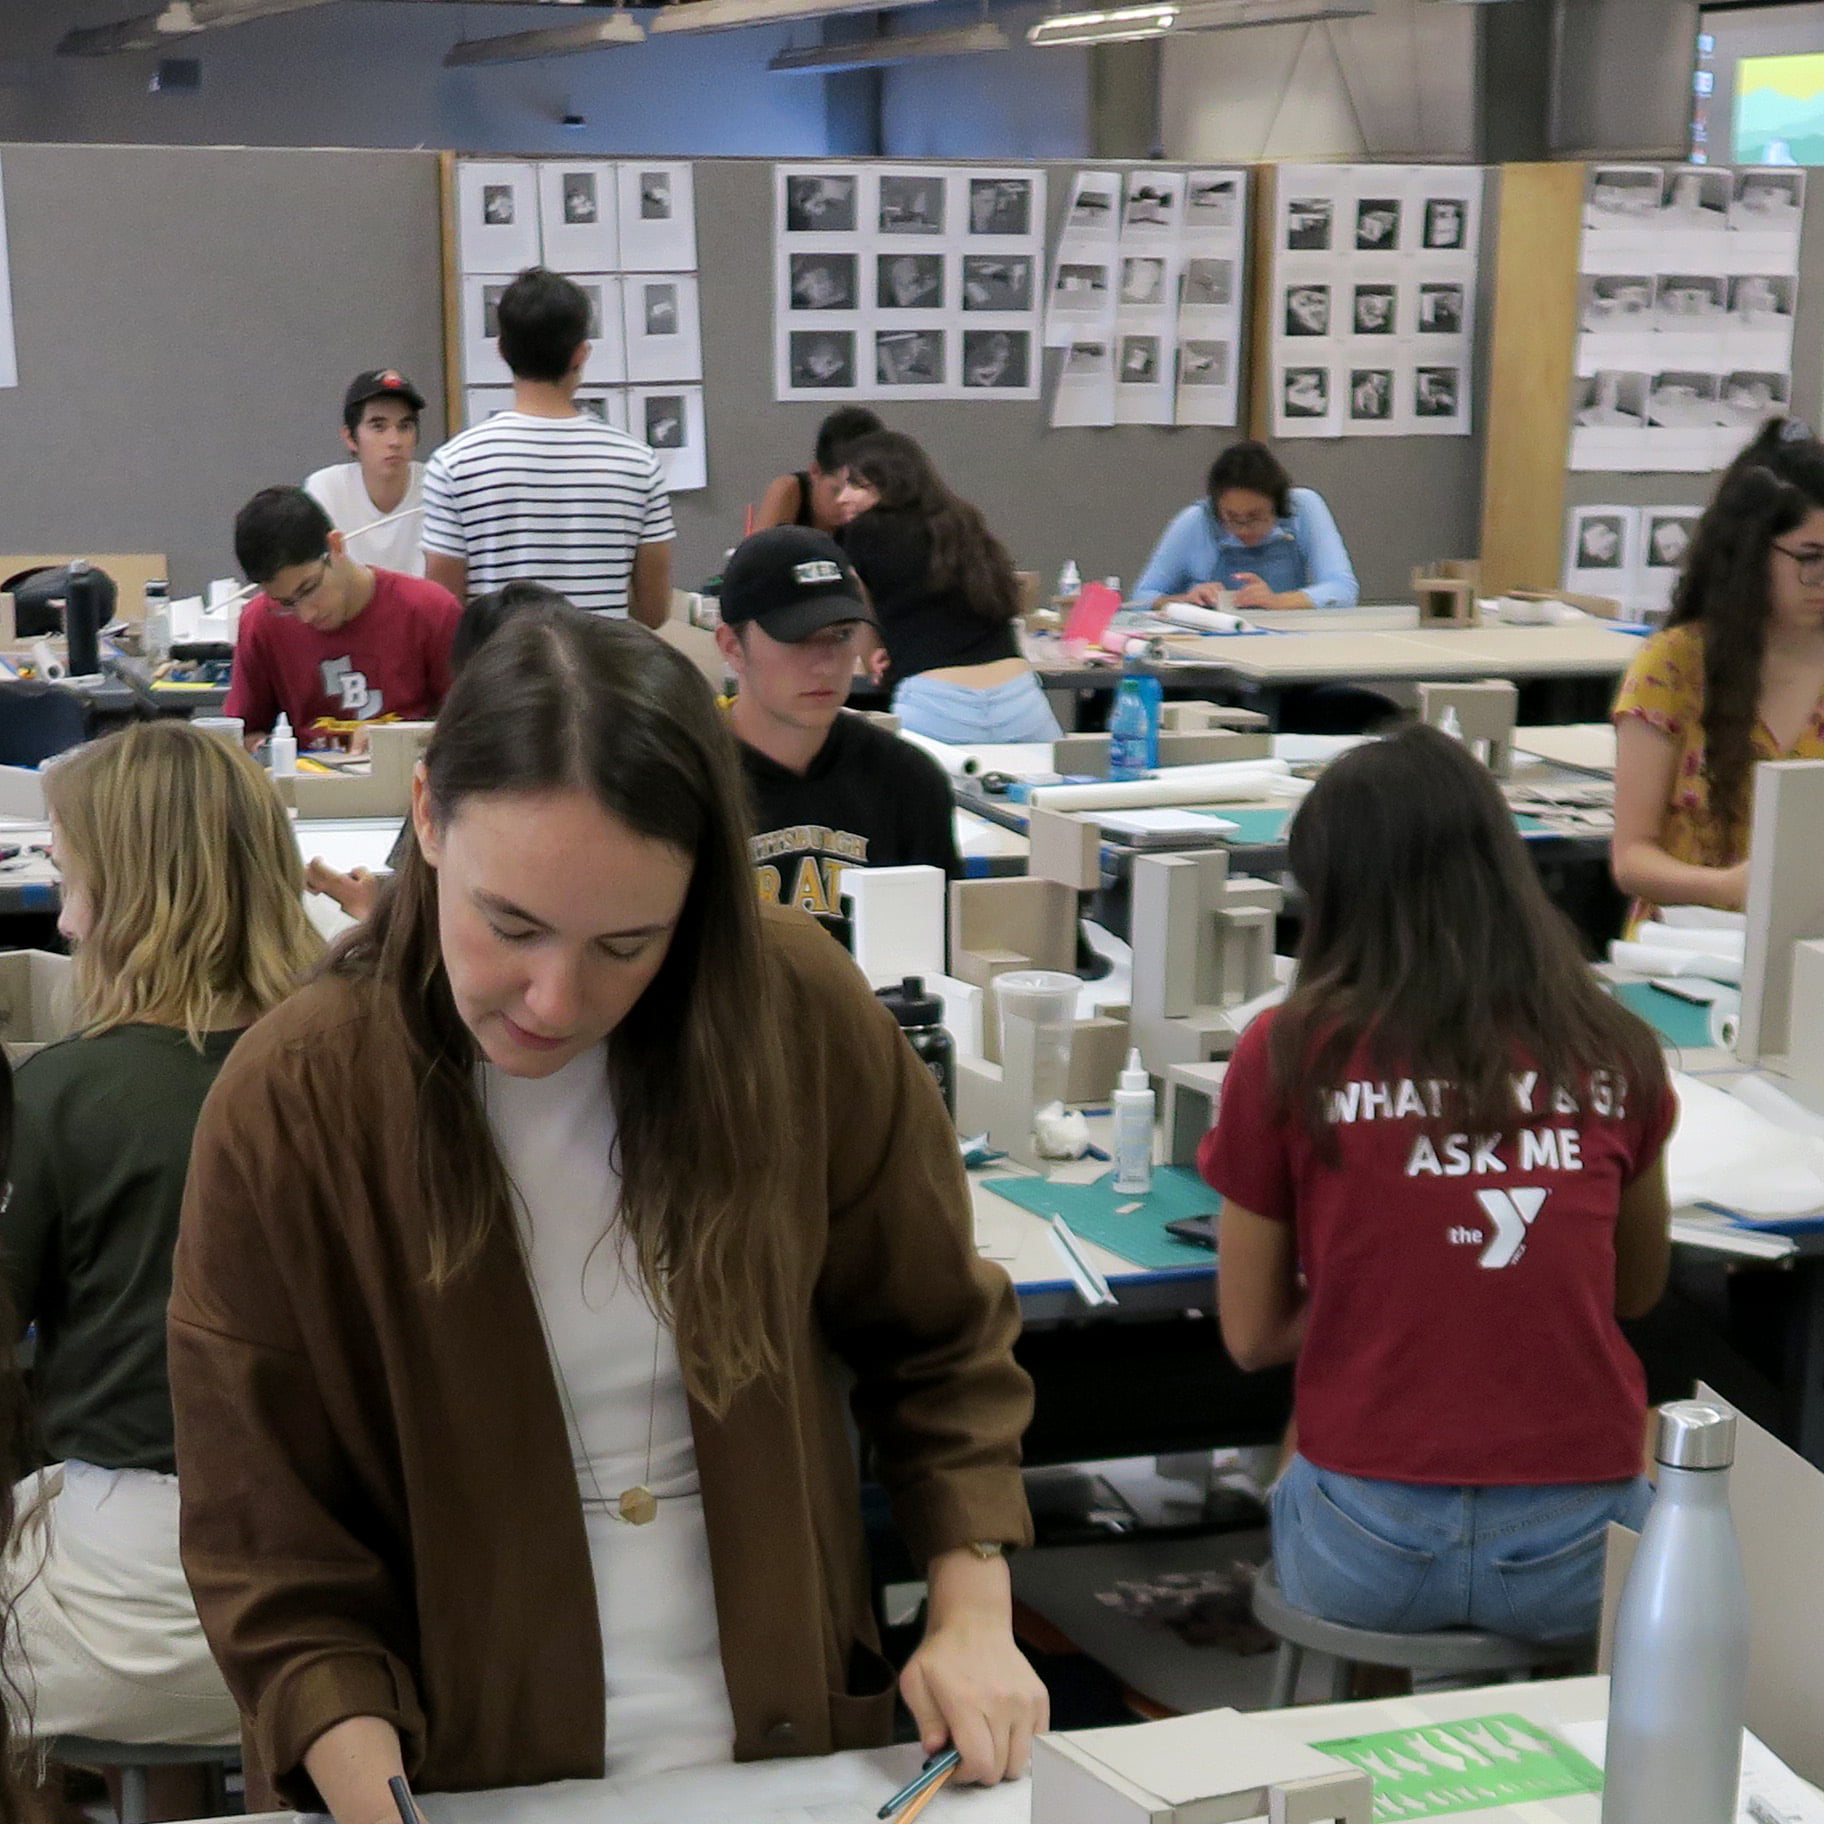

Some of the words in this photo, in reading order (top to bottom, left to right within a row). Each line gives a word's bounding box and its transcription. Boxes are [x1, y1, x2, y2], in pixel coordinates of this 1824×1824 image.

[1406, 1132, 1508, 1177] ASK
[1518, 1128, 1584, 1171] ME
[1448, 1225, 1483, 1245] the
